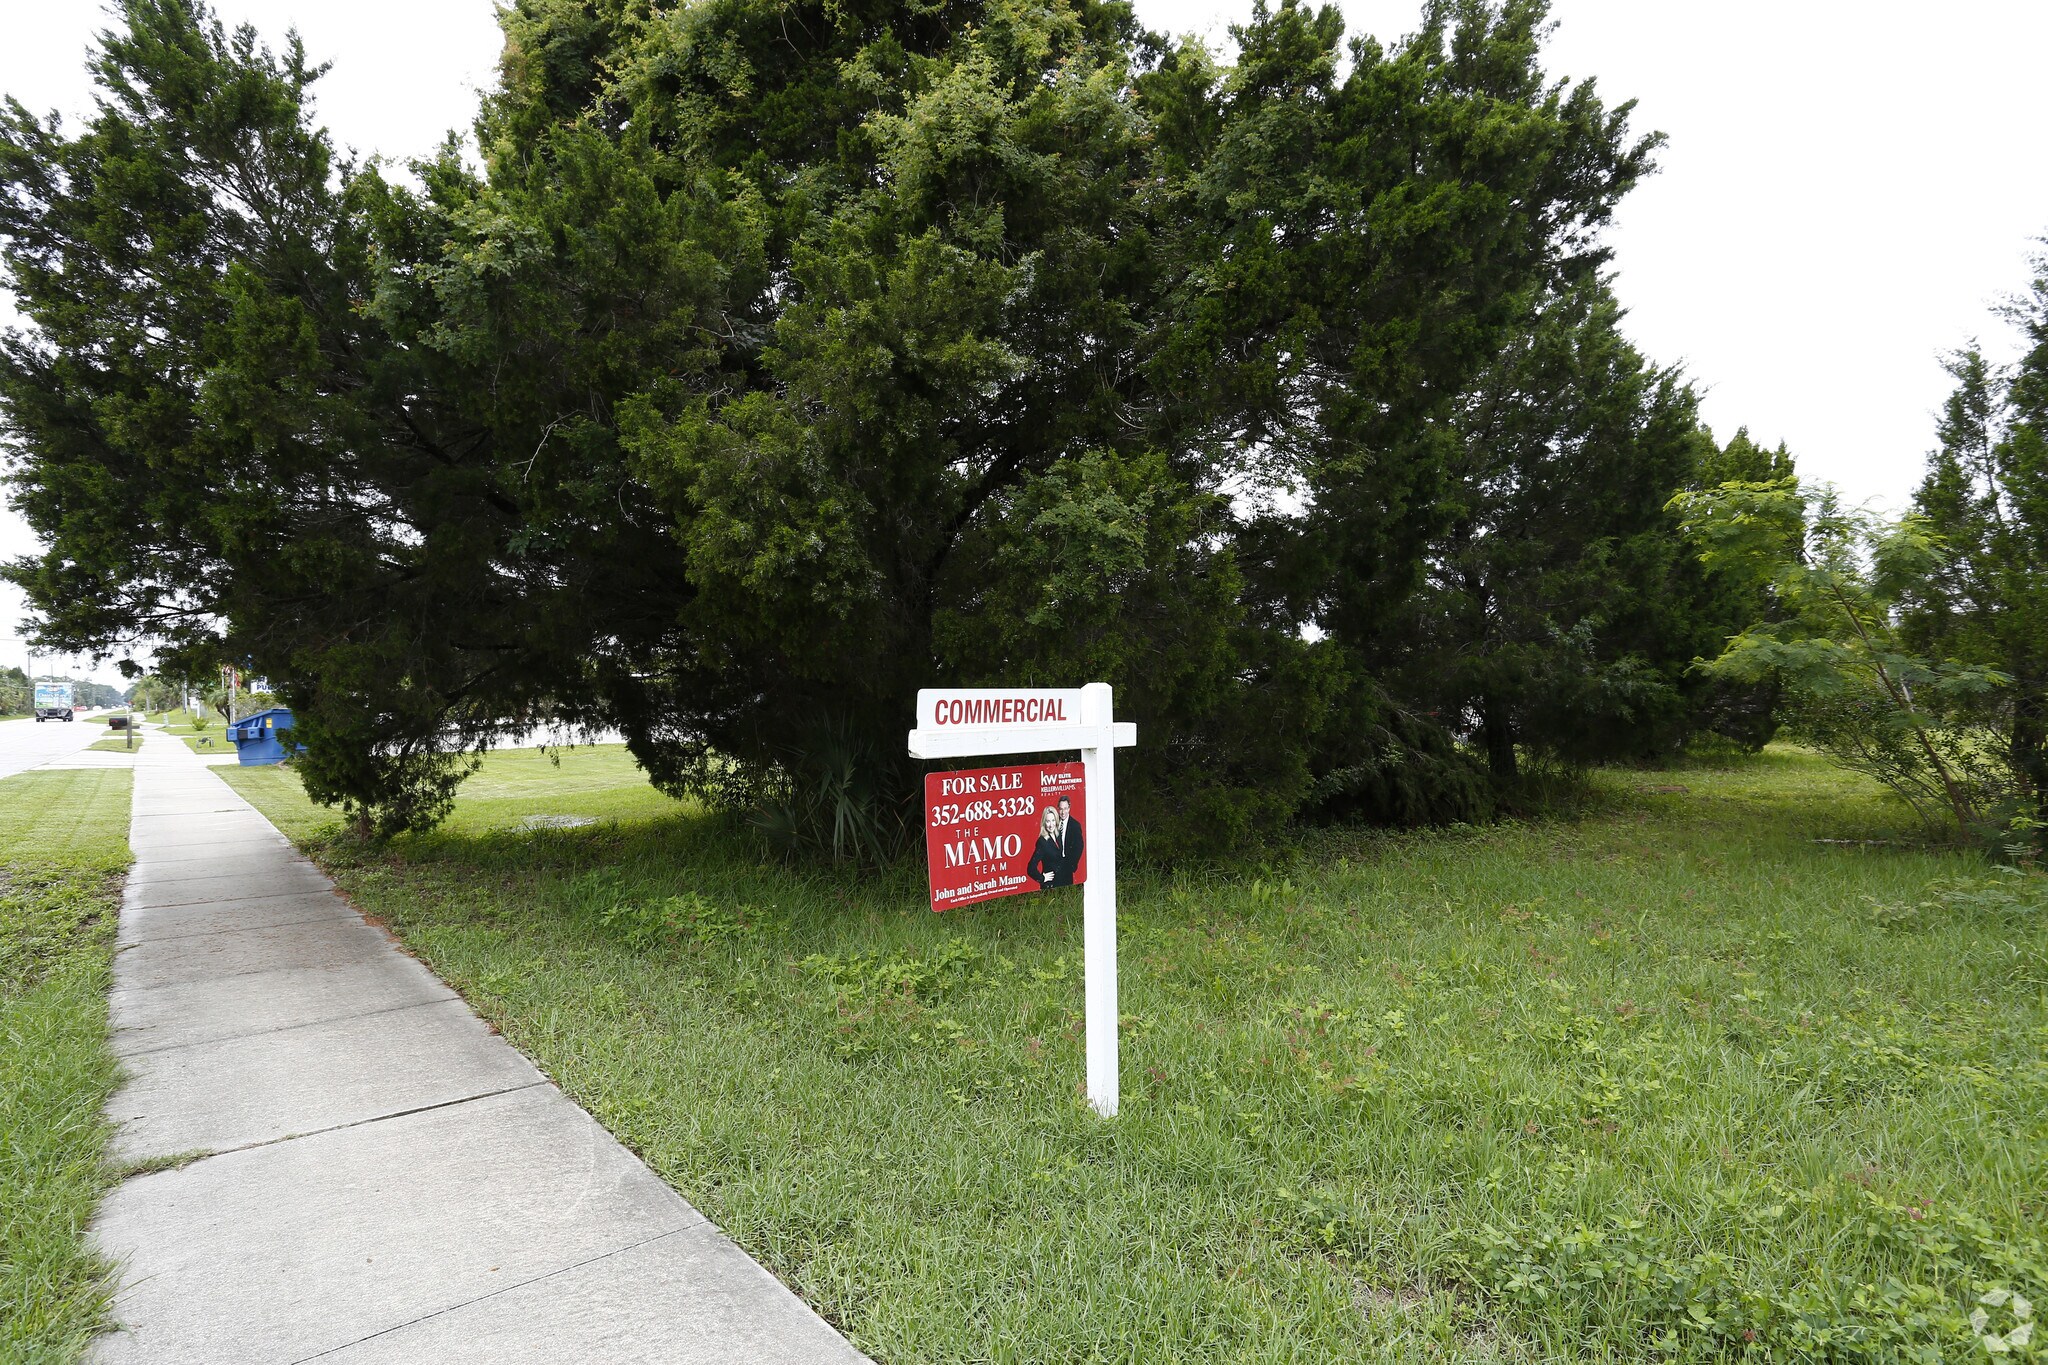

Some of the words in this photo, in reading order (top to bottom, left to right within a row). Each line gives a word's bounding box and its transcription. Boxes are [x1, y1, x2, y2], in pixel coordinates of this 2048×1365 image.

[935, 698, 1067, 725] COMMERCIAL
[942, 776, 976, 796] FOR
[980, 773, 1023, 792] SALE
[931, 795, 1035, 827] 352-688-3328
[955, 827, 979, 838] THE
[943, 833, 1022, 868] MAMO
[975, 862, 1007, 875] TEAM
[934, 888, 955, 902] John
[957, 882, 972, 895] and
[973, 879, 997, 892] Sarah
[999, 875, 1027, 887] Mamo
